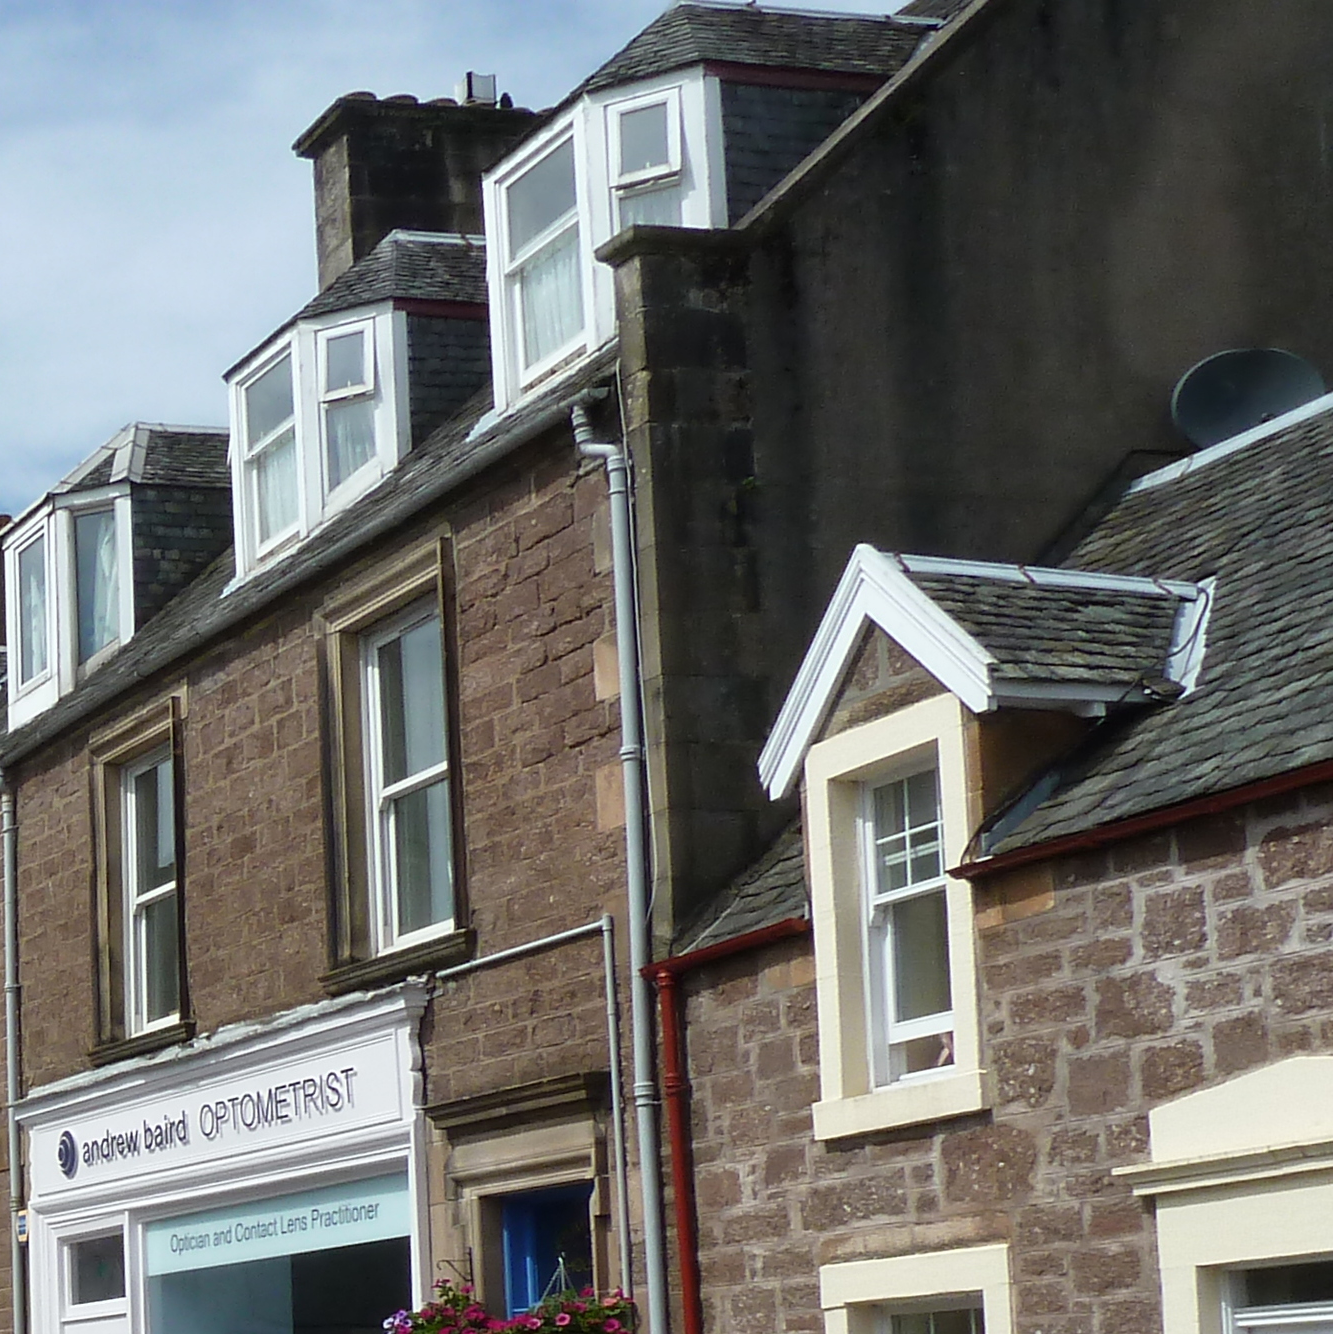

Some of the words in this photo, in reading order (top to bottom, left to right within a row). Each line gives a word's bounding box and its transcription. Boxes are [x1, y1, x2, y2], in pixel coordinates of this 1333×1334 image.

[82, 1129, 139, 1164] andrew
[143, 1110, 188, 1150] baird
[199, 1067, 355, 1138] OPTOMETRIST
[170, 1232, 210, 1256] Optician
[213, 1226, 232, 1247] and
[234, 1219, 278, 1243] Contact
[280, 1215, 308, 1235] Lens
[311, 1202, 380, 1230] Practitioner
